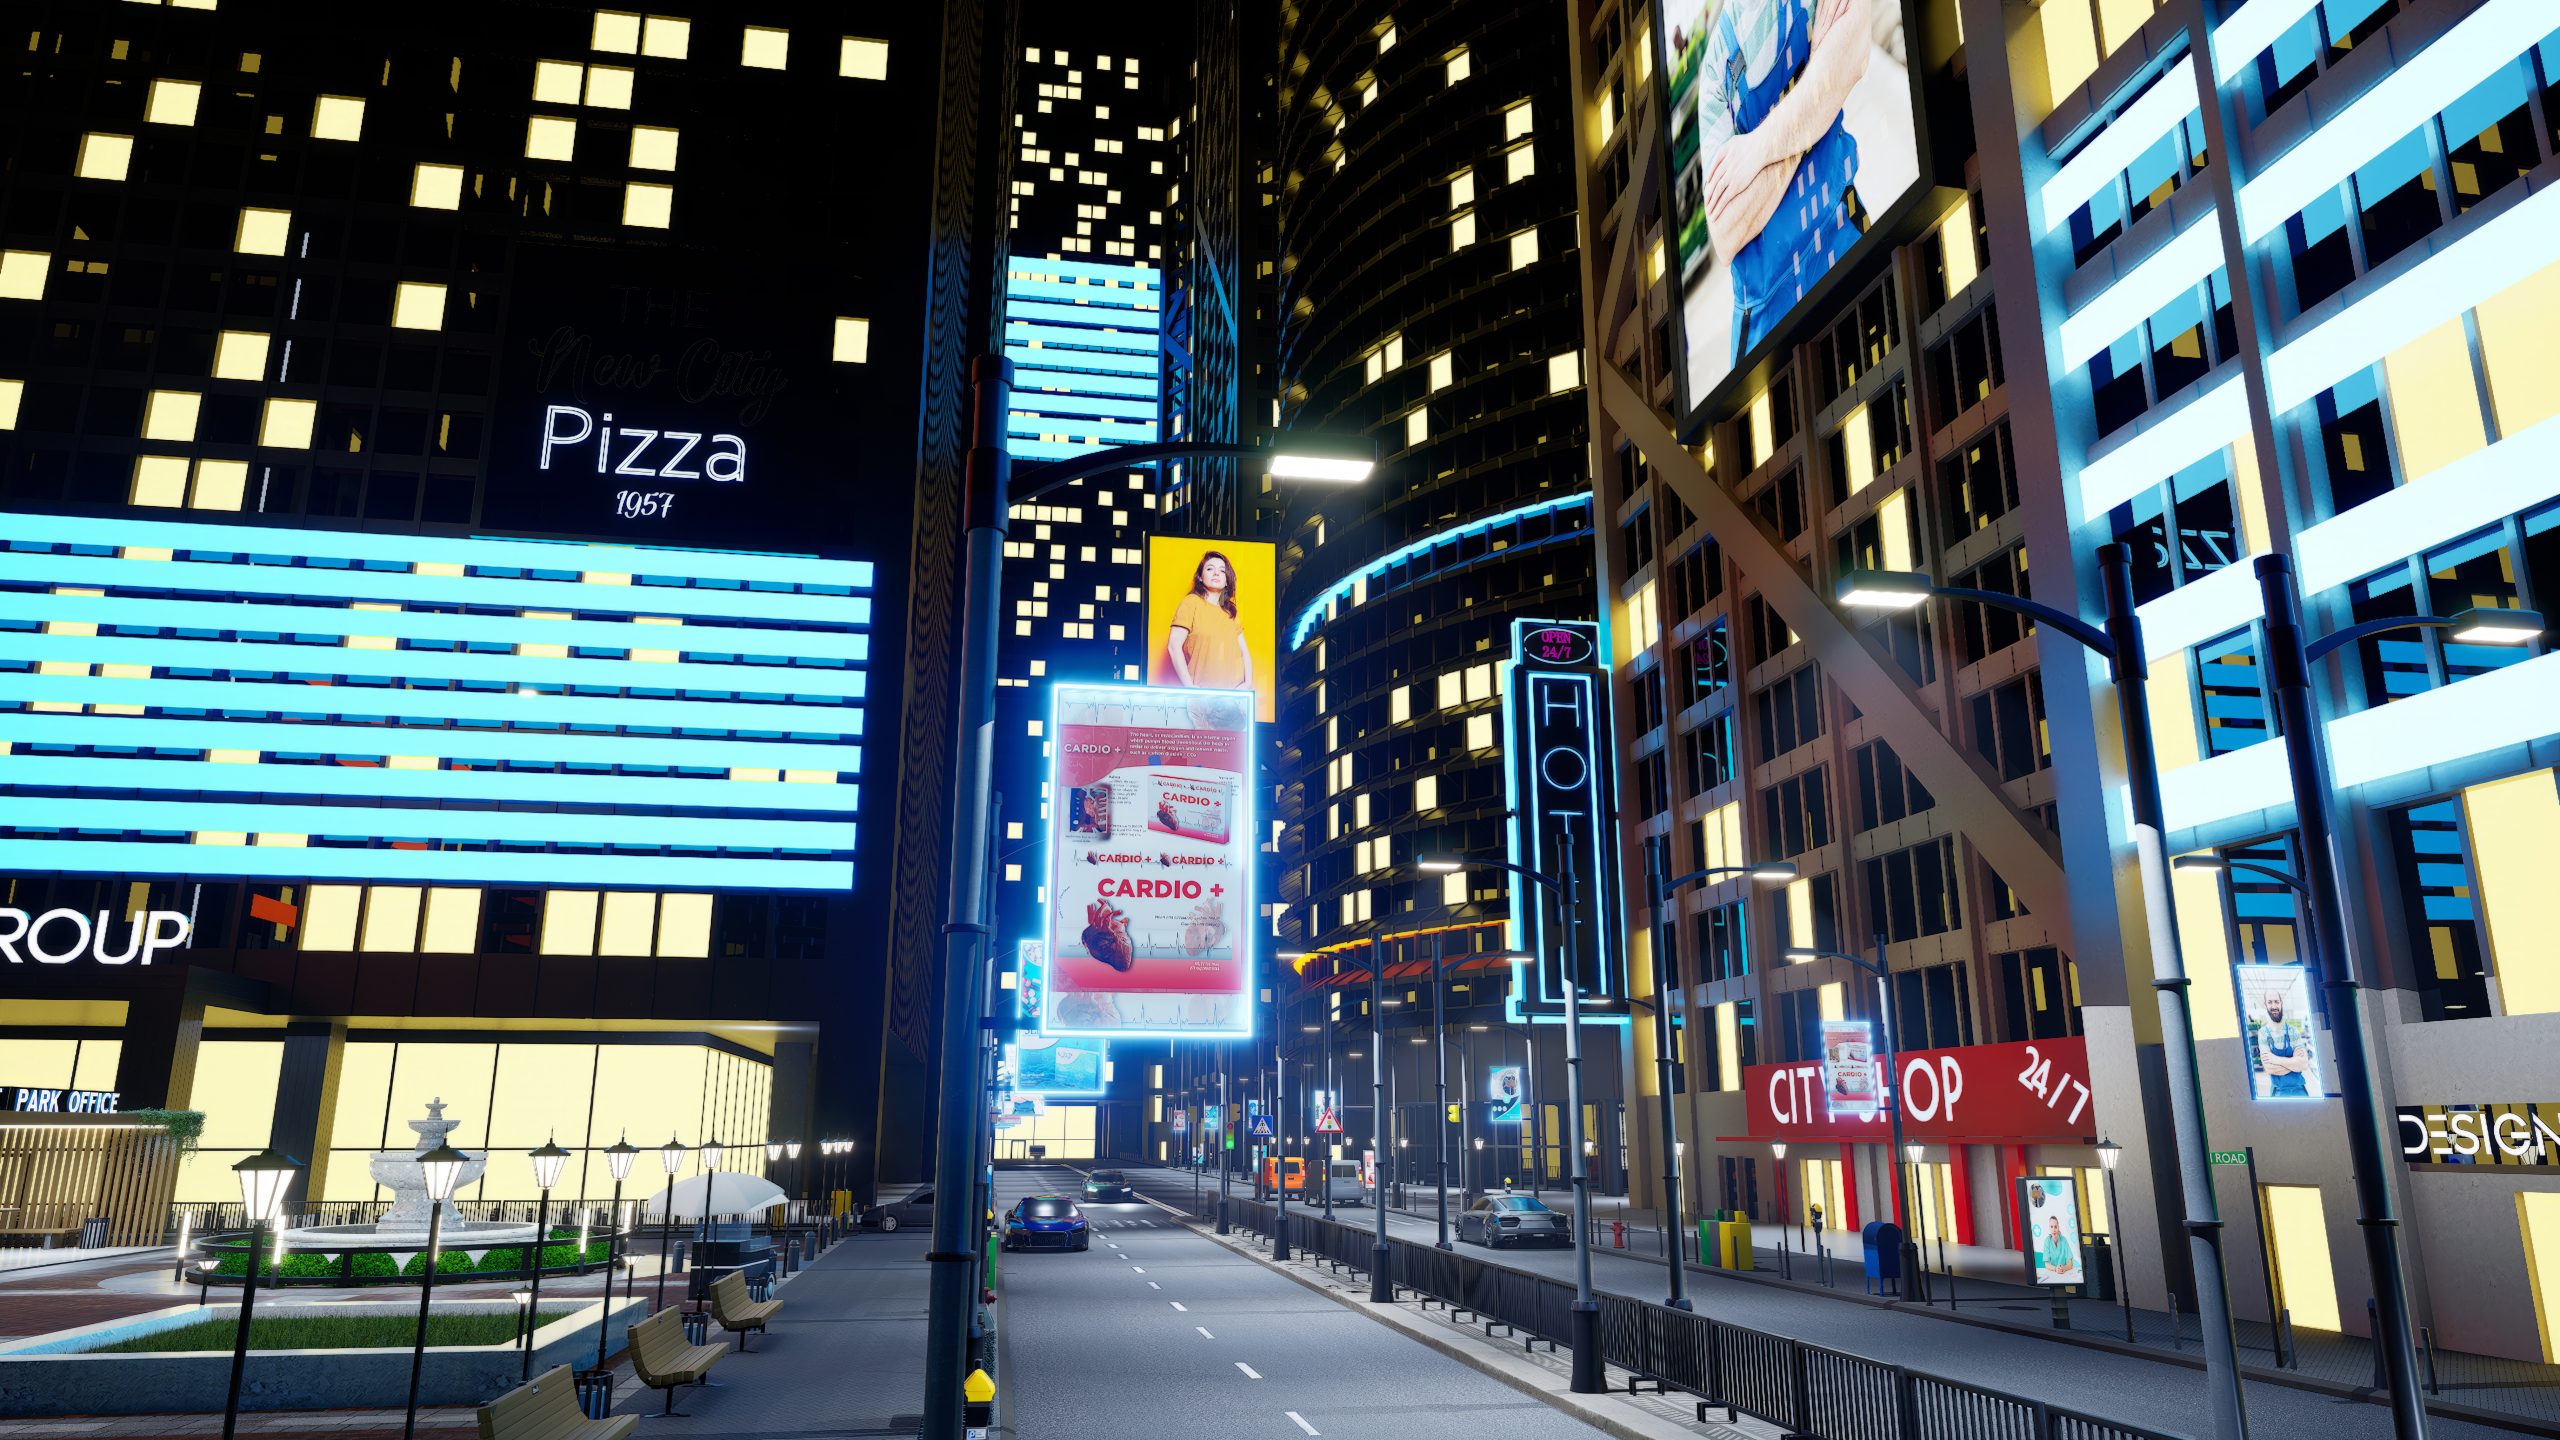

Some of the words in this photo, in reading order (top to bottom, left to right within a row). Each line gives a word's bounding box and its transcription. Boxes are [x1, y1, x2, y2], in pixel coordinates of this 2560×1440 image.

[540, 404, 747, 482] Pizza
[616, 490, 675, 518] 1957
[1541, 630, 1571, 644] OPEN
[1542, 645, 1571, 659] 24/7
[1064, 743, 1111, 754] CARDIO
[1163, 792, 1210, 806] CARDIO
[1099, 854, 1142, 863] CARDIO
[1172, 856, 1214, 865] CARDIO
[1098, 878, 1202, 899] CARDIO
[1858, 1056, 1963, 1124] HOP
[2017, 1046, 2090, 1125] 24/7
[15, 1088, 62, 1112] PARK
[67, 1090, 120, 1114] OFFICE
[2397, 1112, 2560, 1157] DESIGN
[2215, 1153, 2246, 1164] ROAD
